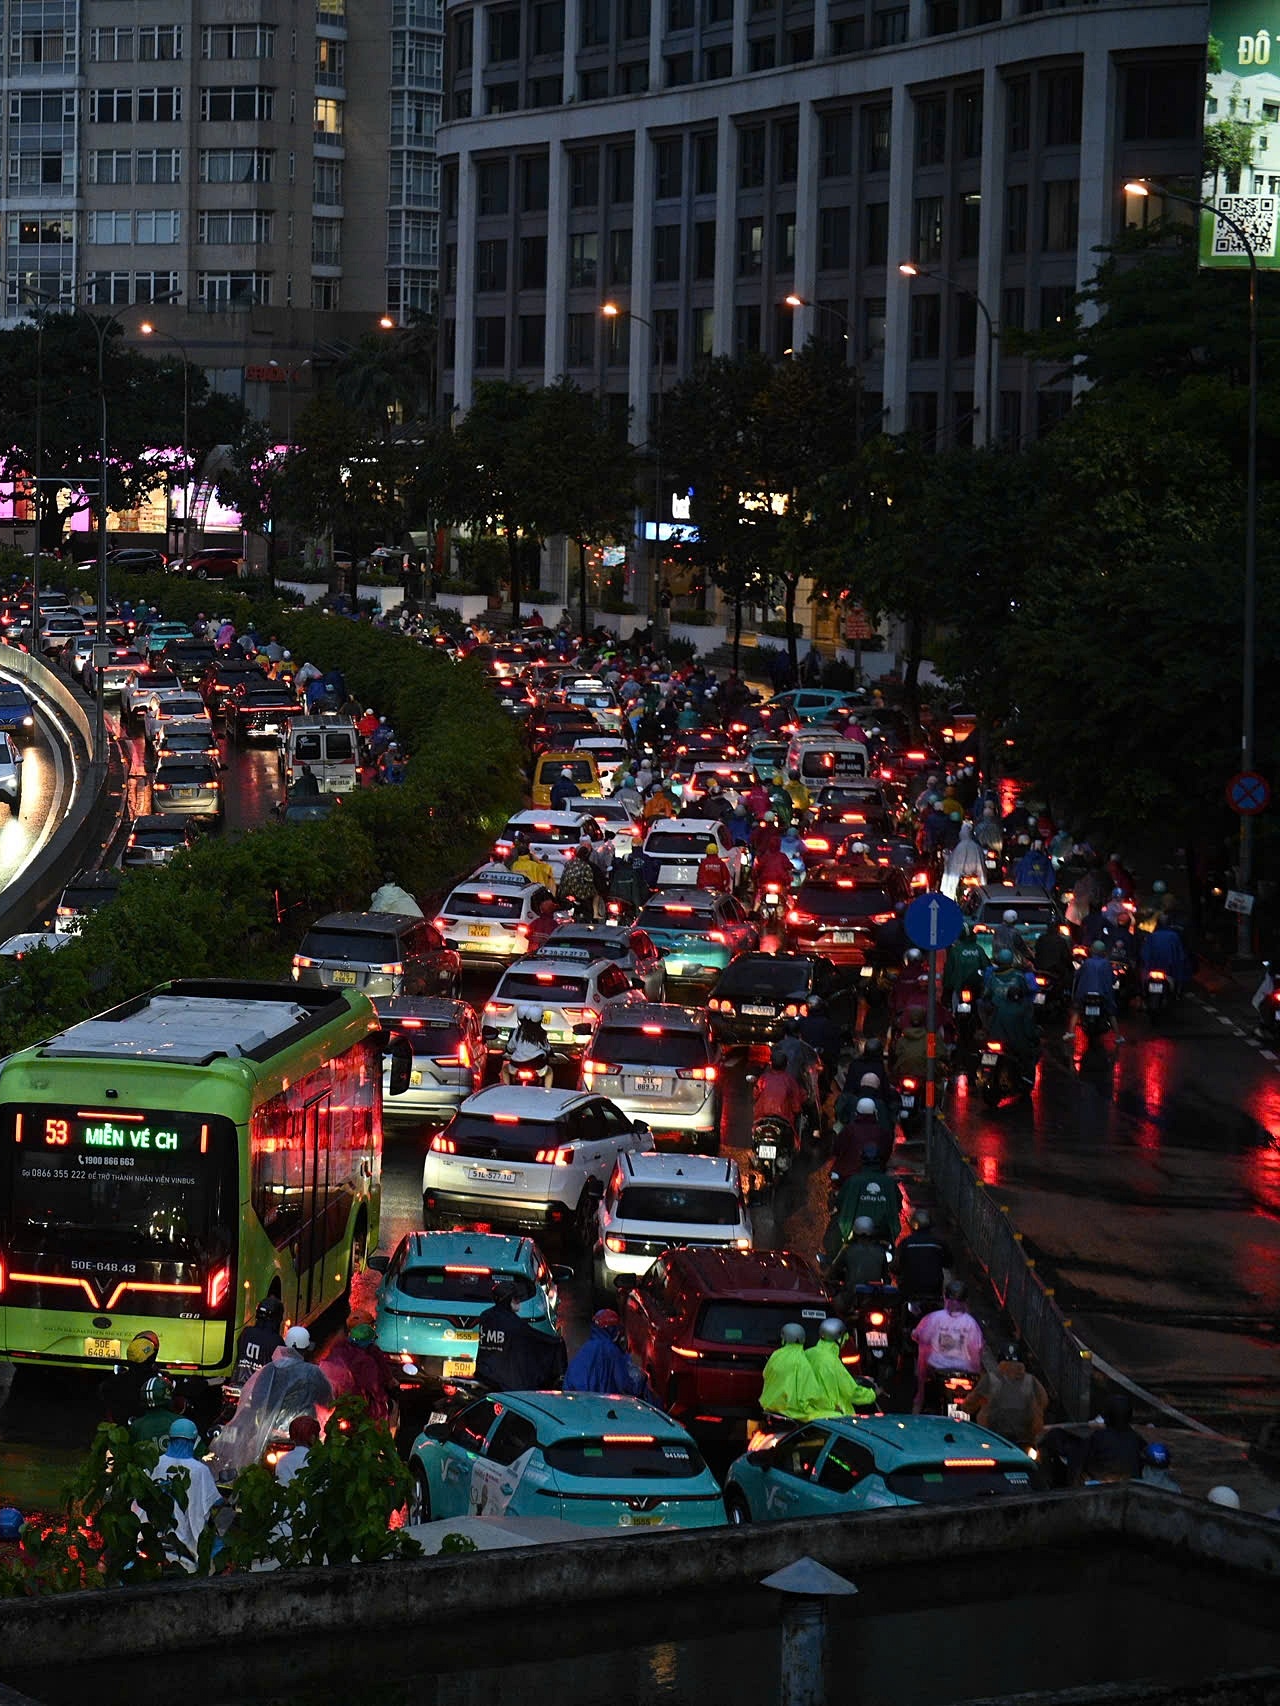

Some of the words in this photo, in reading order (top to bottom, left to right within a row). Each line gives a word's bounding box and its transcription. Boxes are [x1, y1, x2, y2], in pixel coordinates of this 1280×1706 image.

[1237, 29, 1271, 65] ĐÔ
[46, 1119, 68, 1145] 53
[85, 1122, 124, 1147] MIỄN
[130, 1128, 150, 1148] VÉ
[155, 1132, 178, 1150] CH
[85, 1156, 102, 1165] 1900
[104, 1156, 118, 1166] 866
[32, 1168, 52, 1178] 0866
[54, 1169, 69, 1178] 355
[71, 1170, 86, 1179] 222
[171, 1178, 196, 1186] VINBUS
[71, 1260, 136, 1274] 50E-648.43
[94, 1340, 110, 1349] 50E
[486, 1330, 505, 1344] MB
